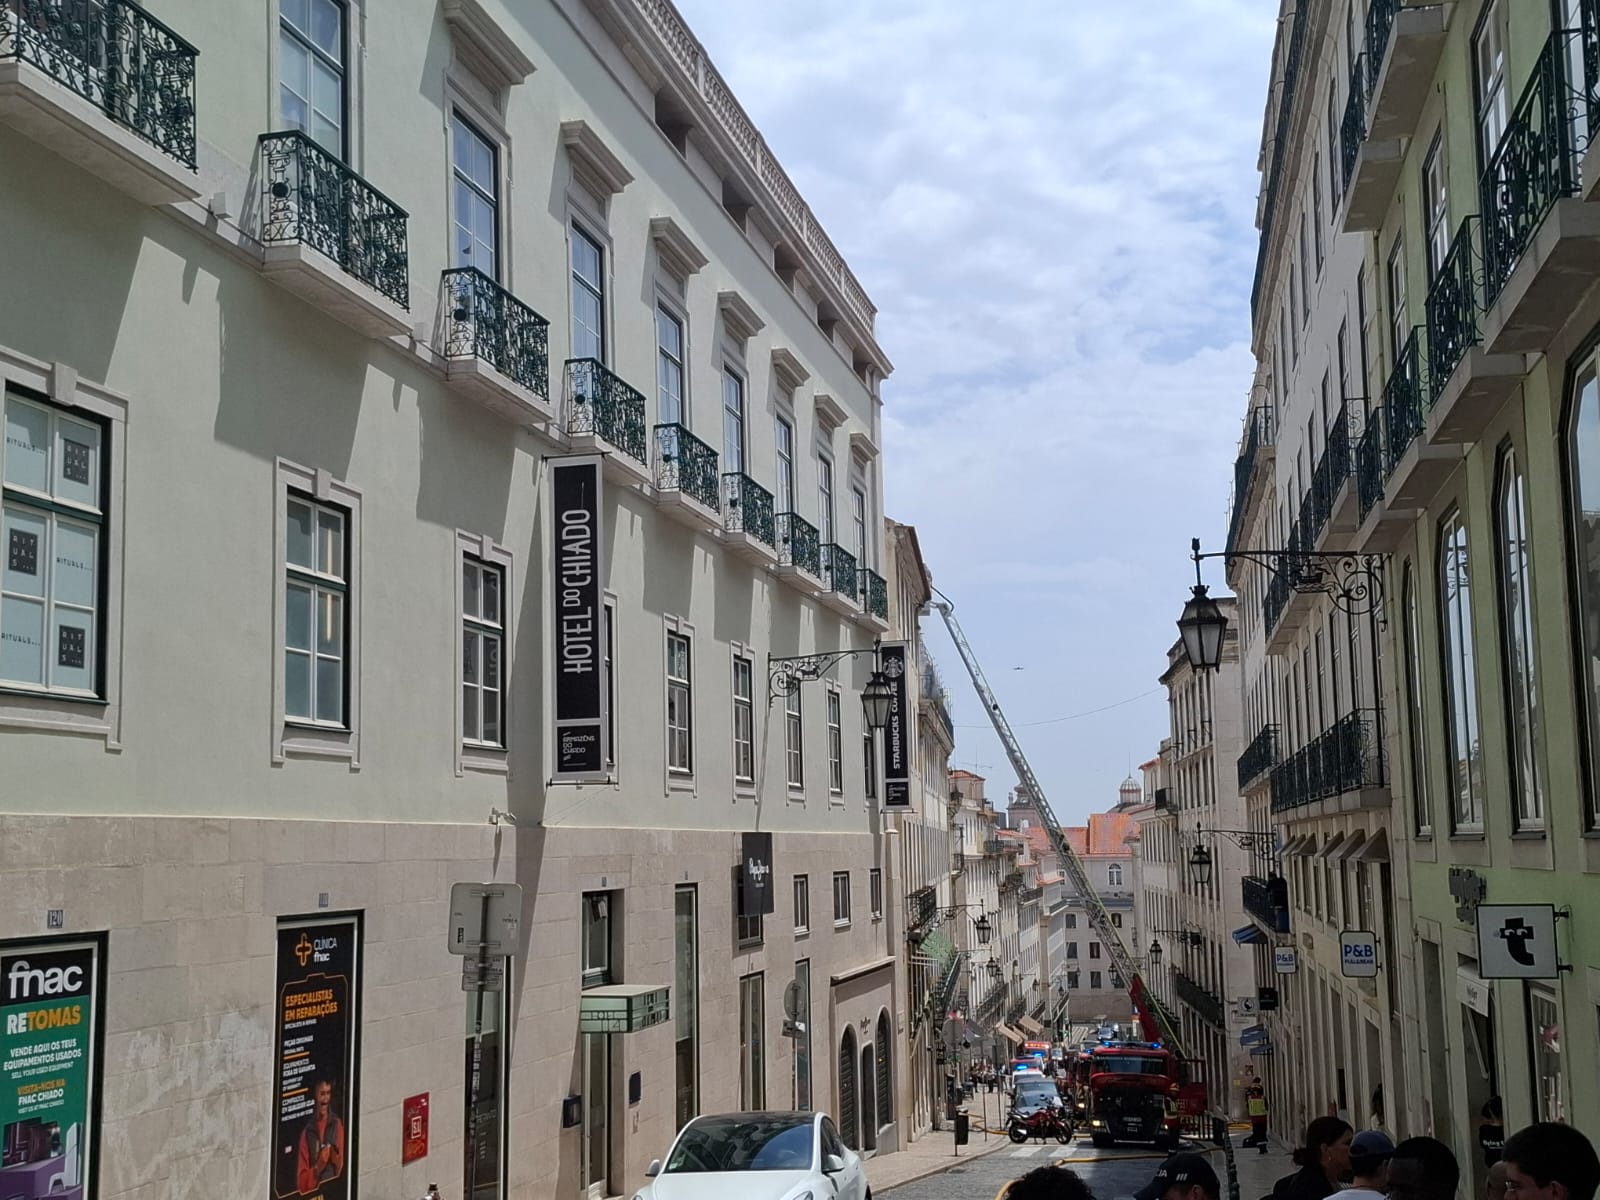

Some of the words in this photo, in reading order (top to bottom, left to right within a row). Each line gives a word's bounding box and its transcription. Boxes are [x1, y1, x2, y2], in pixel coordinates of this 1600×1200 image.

[562, 509, 592, 587] CHIADO
[563, 589, 581, 607] DO
[563, 606, 593, 674] HOTEL
[890, 681, 898, 713] COEE
[891, 715, 901, 770] STARBUCKS
[1276, 953, 1294, 962] P&B
[1343, 944, 1374, 957] P&B
[8, 960, 83, 999] fnac
[285, 989, 333, 1007] ESPECIALISTAS
[7, 1005, 81, 1035] RETOMAS
[285, 1009, 296, 1021] EM
[296, 1001, 338, 1019] REPARAÇÕES
[10, 1045, 33, 1058] VENDE
[33, 1042, 50, 1054] AQUI
[50, 1041, 61, 1051] OS
[61, 1038, 77, 1049] TEUS
[3, 1053, 55, 1071] EQUIPAMENTOS
[55, 1048, 82, 1061] USADOS
[18, 1093, 37, 1106] FNAC
[37, 1088, 64, 1102] CHIADO
